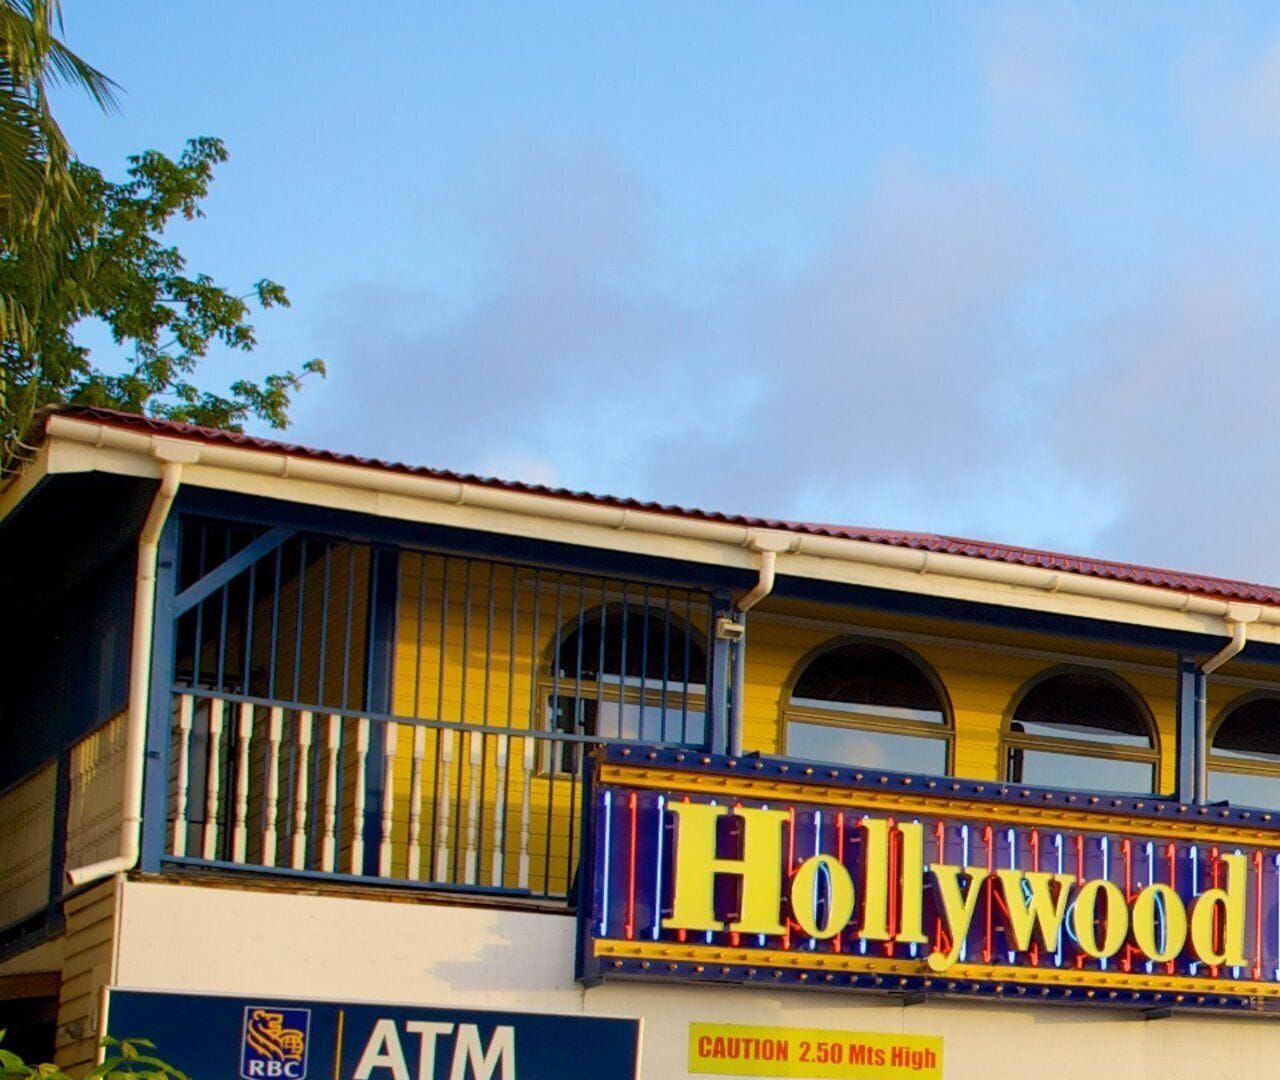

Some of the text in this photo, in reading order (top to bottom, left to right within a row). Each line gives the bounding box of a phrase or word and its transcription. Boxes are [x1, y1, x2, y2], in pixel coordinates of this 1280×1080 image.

[662, 800, 1249, 973] Hollywood
[248, 1058, 301, 1078] RBC
[697, 1035, 937, 1072] CAUTION 2.50 Mts High
